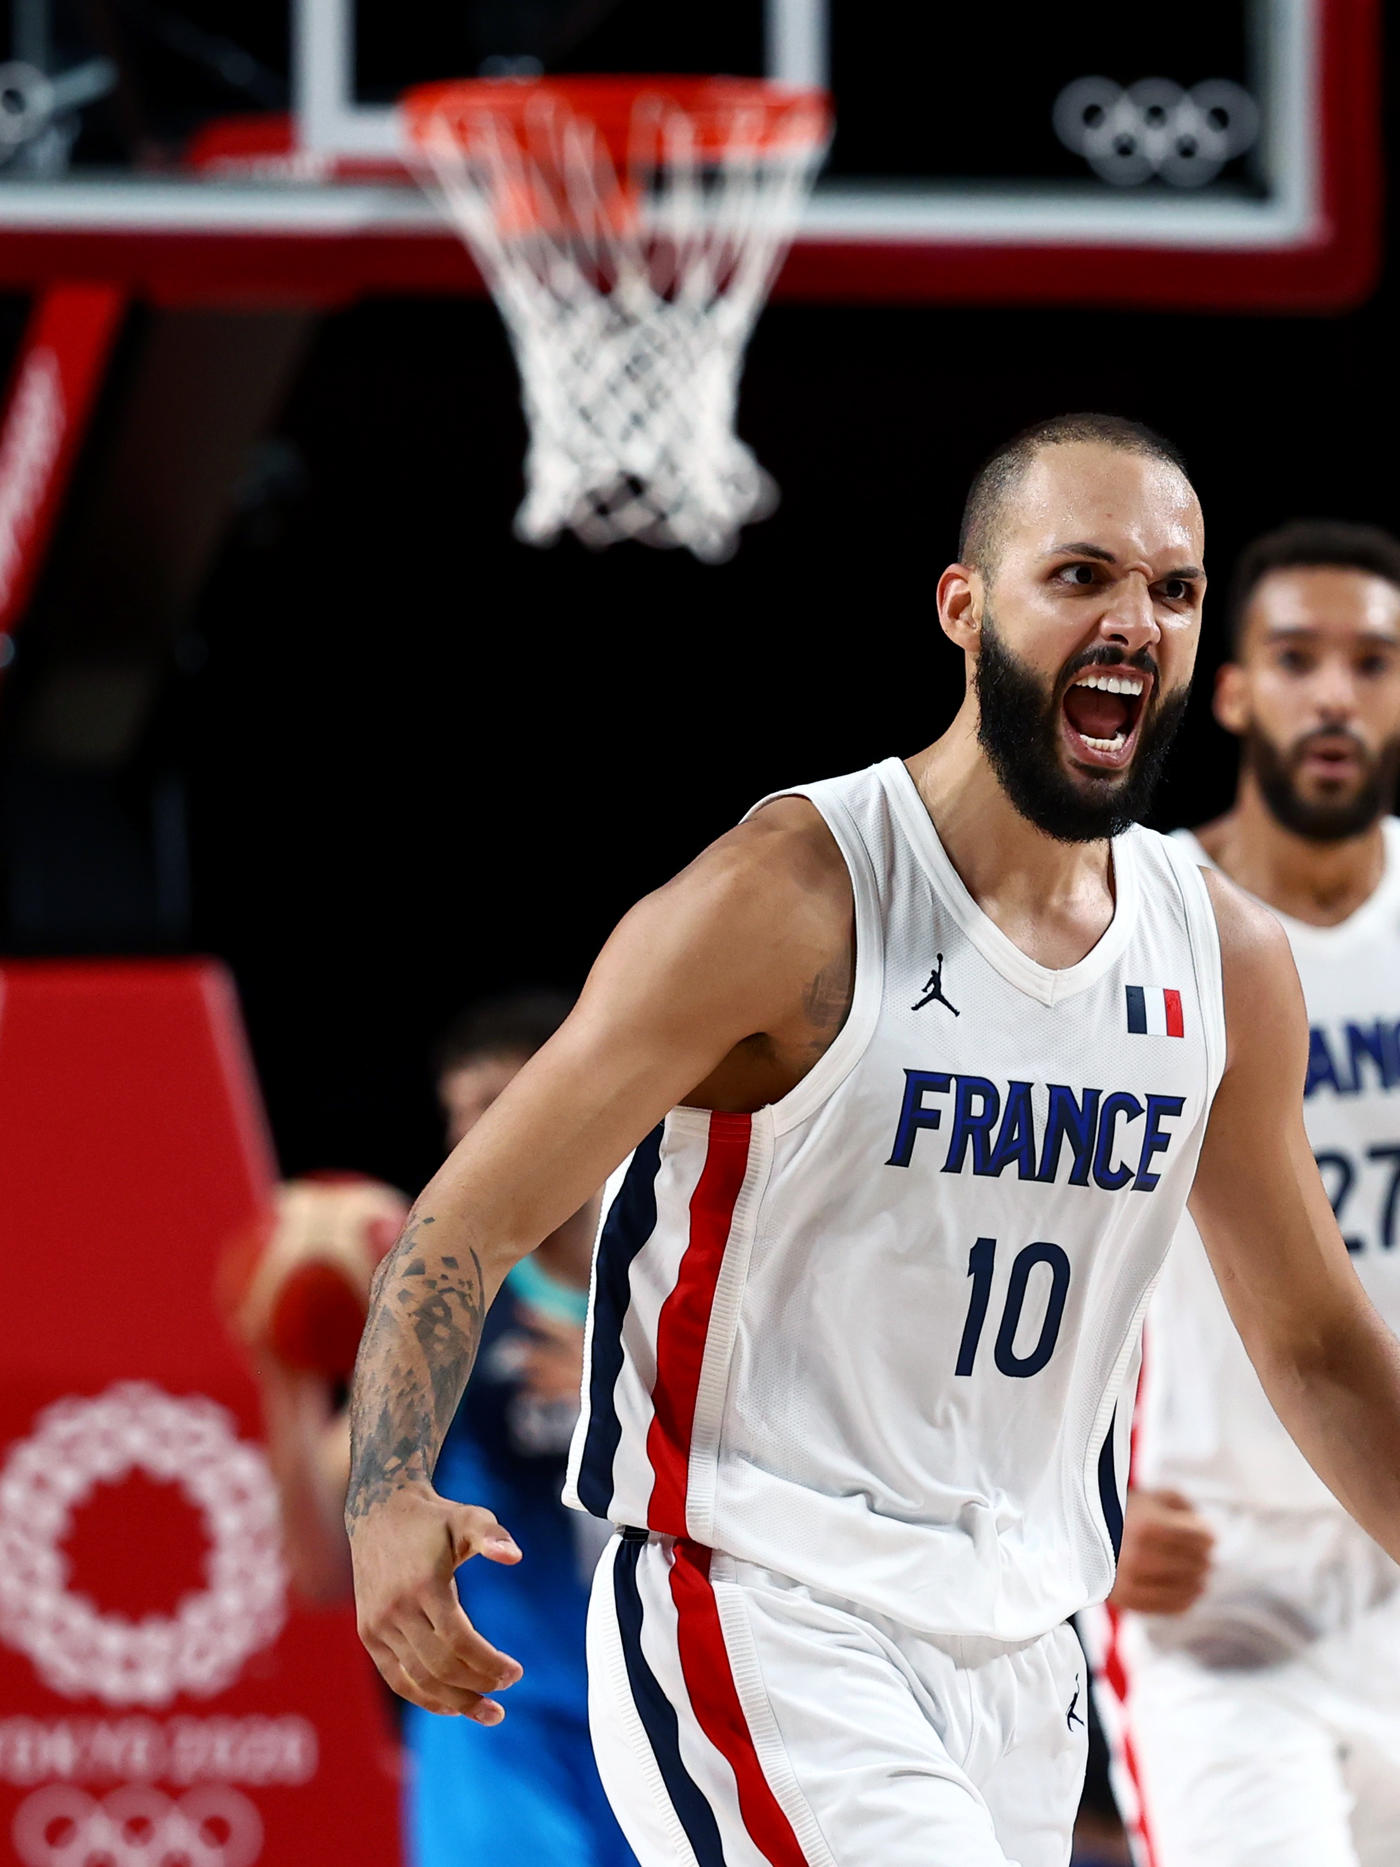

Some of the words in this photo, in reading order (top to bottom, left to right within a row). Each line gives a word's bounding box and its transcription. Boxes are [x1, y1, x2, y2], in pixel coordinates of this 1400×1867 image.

[884, 1067, 1187, 1192] FRANCE
[954, 1237, 1071, 1378] 10
[0, 1715, 166, 1786] OKYO
